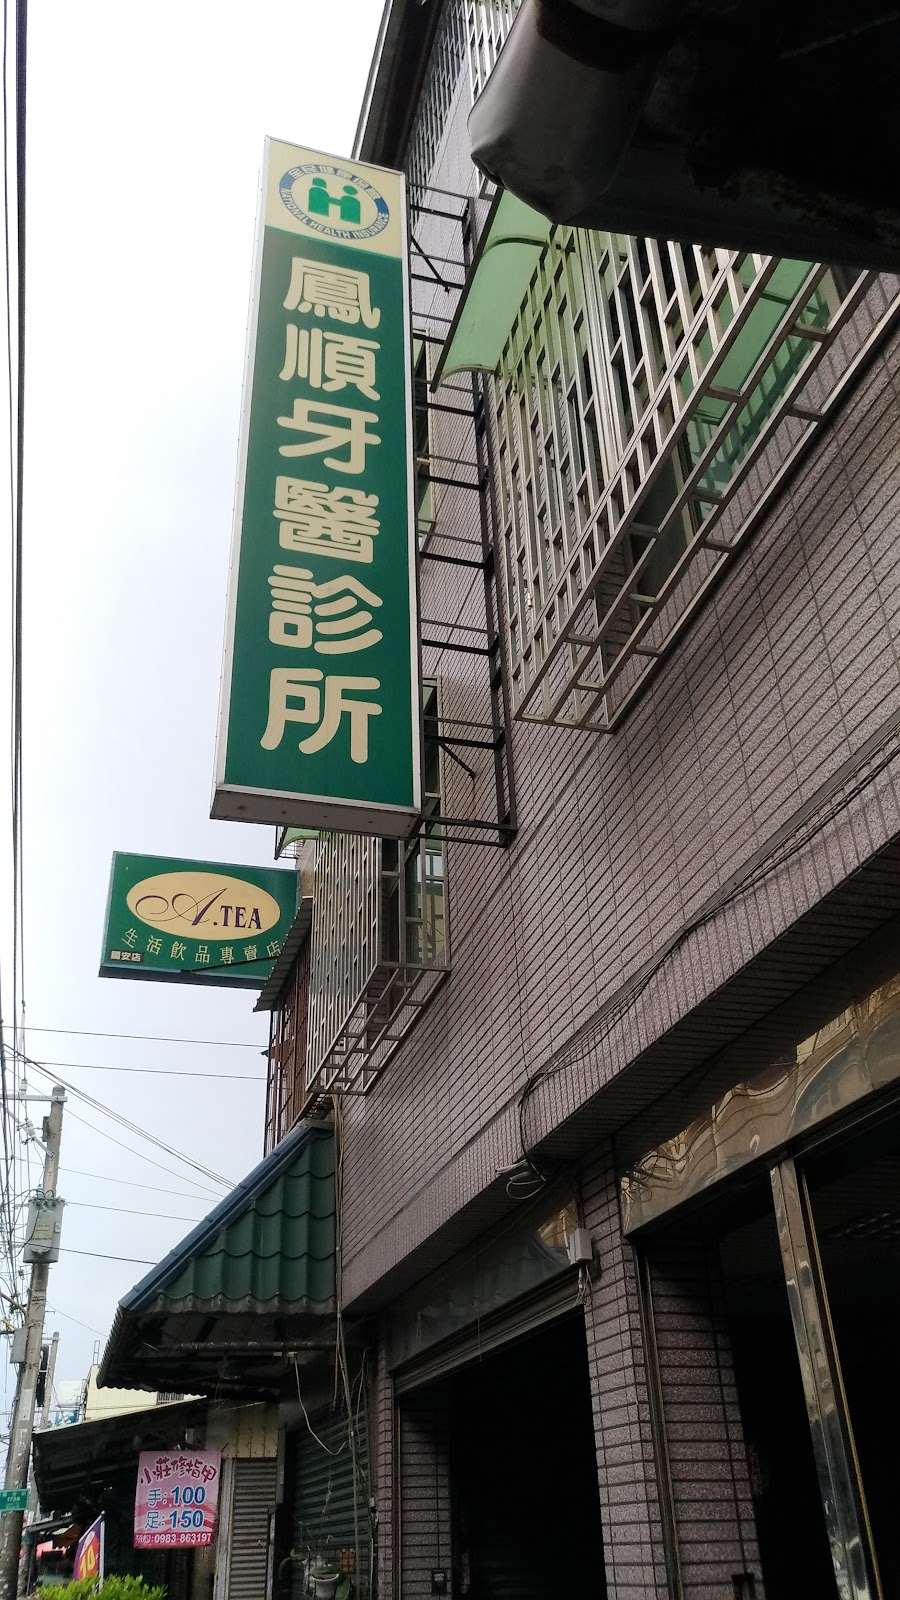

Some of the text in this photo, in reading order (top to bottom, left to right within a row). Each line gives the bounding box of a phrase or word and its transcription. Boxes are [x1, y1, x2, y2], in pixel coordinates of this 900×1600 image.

[280, 188, 389, 239] NATIONAL HEALTH INSURANCE
[260, 256, 383, 764] 鳳順牙醫診所
[121, 927, 282, 964] 生活飲品專賣店
[140, 1455, 217, 1484] 小莊修指甲
